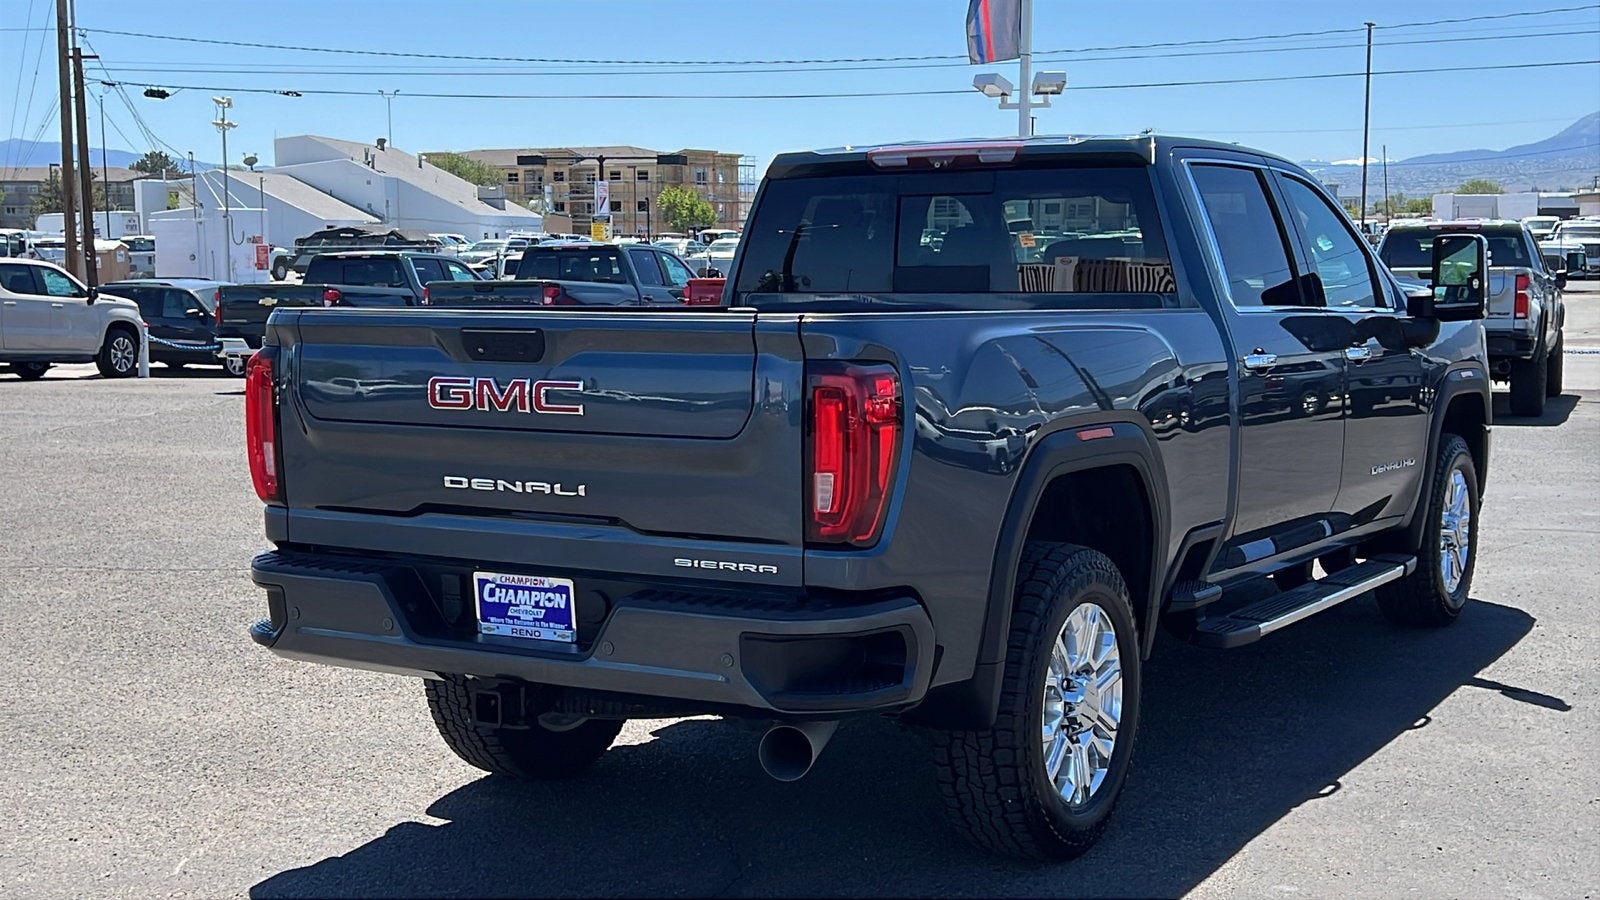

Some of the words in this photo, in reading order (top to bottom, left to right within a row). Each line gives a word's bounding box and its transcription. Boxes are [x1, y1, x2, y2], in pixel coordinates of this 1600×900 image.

[427, 376, 584, 416] GMC
[1371, 459, 1402, 475] DENALI
[1403, 457, 1416, 468] HD
[443, 475, 586, 497] DENALI
[674, 558, 778, 574] SIERRA
[500, 575, 545, 587] CHAMPION
[483, 582, 567, 609] CHAMPION
[509, 608, 542, 617] CHEVROLET
[511, 628, 541, 638] RENO
